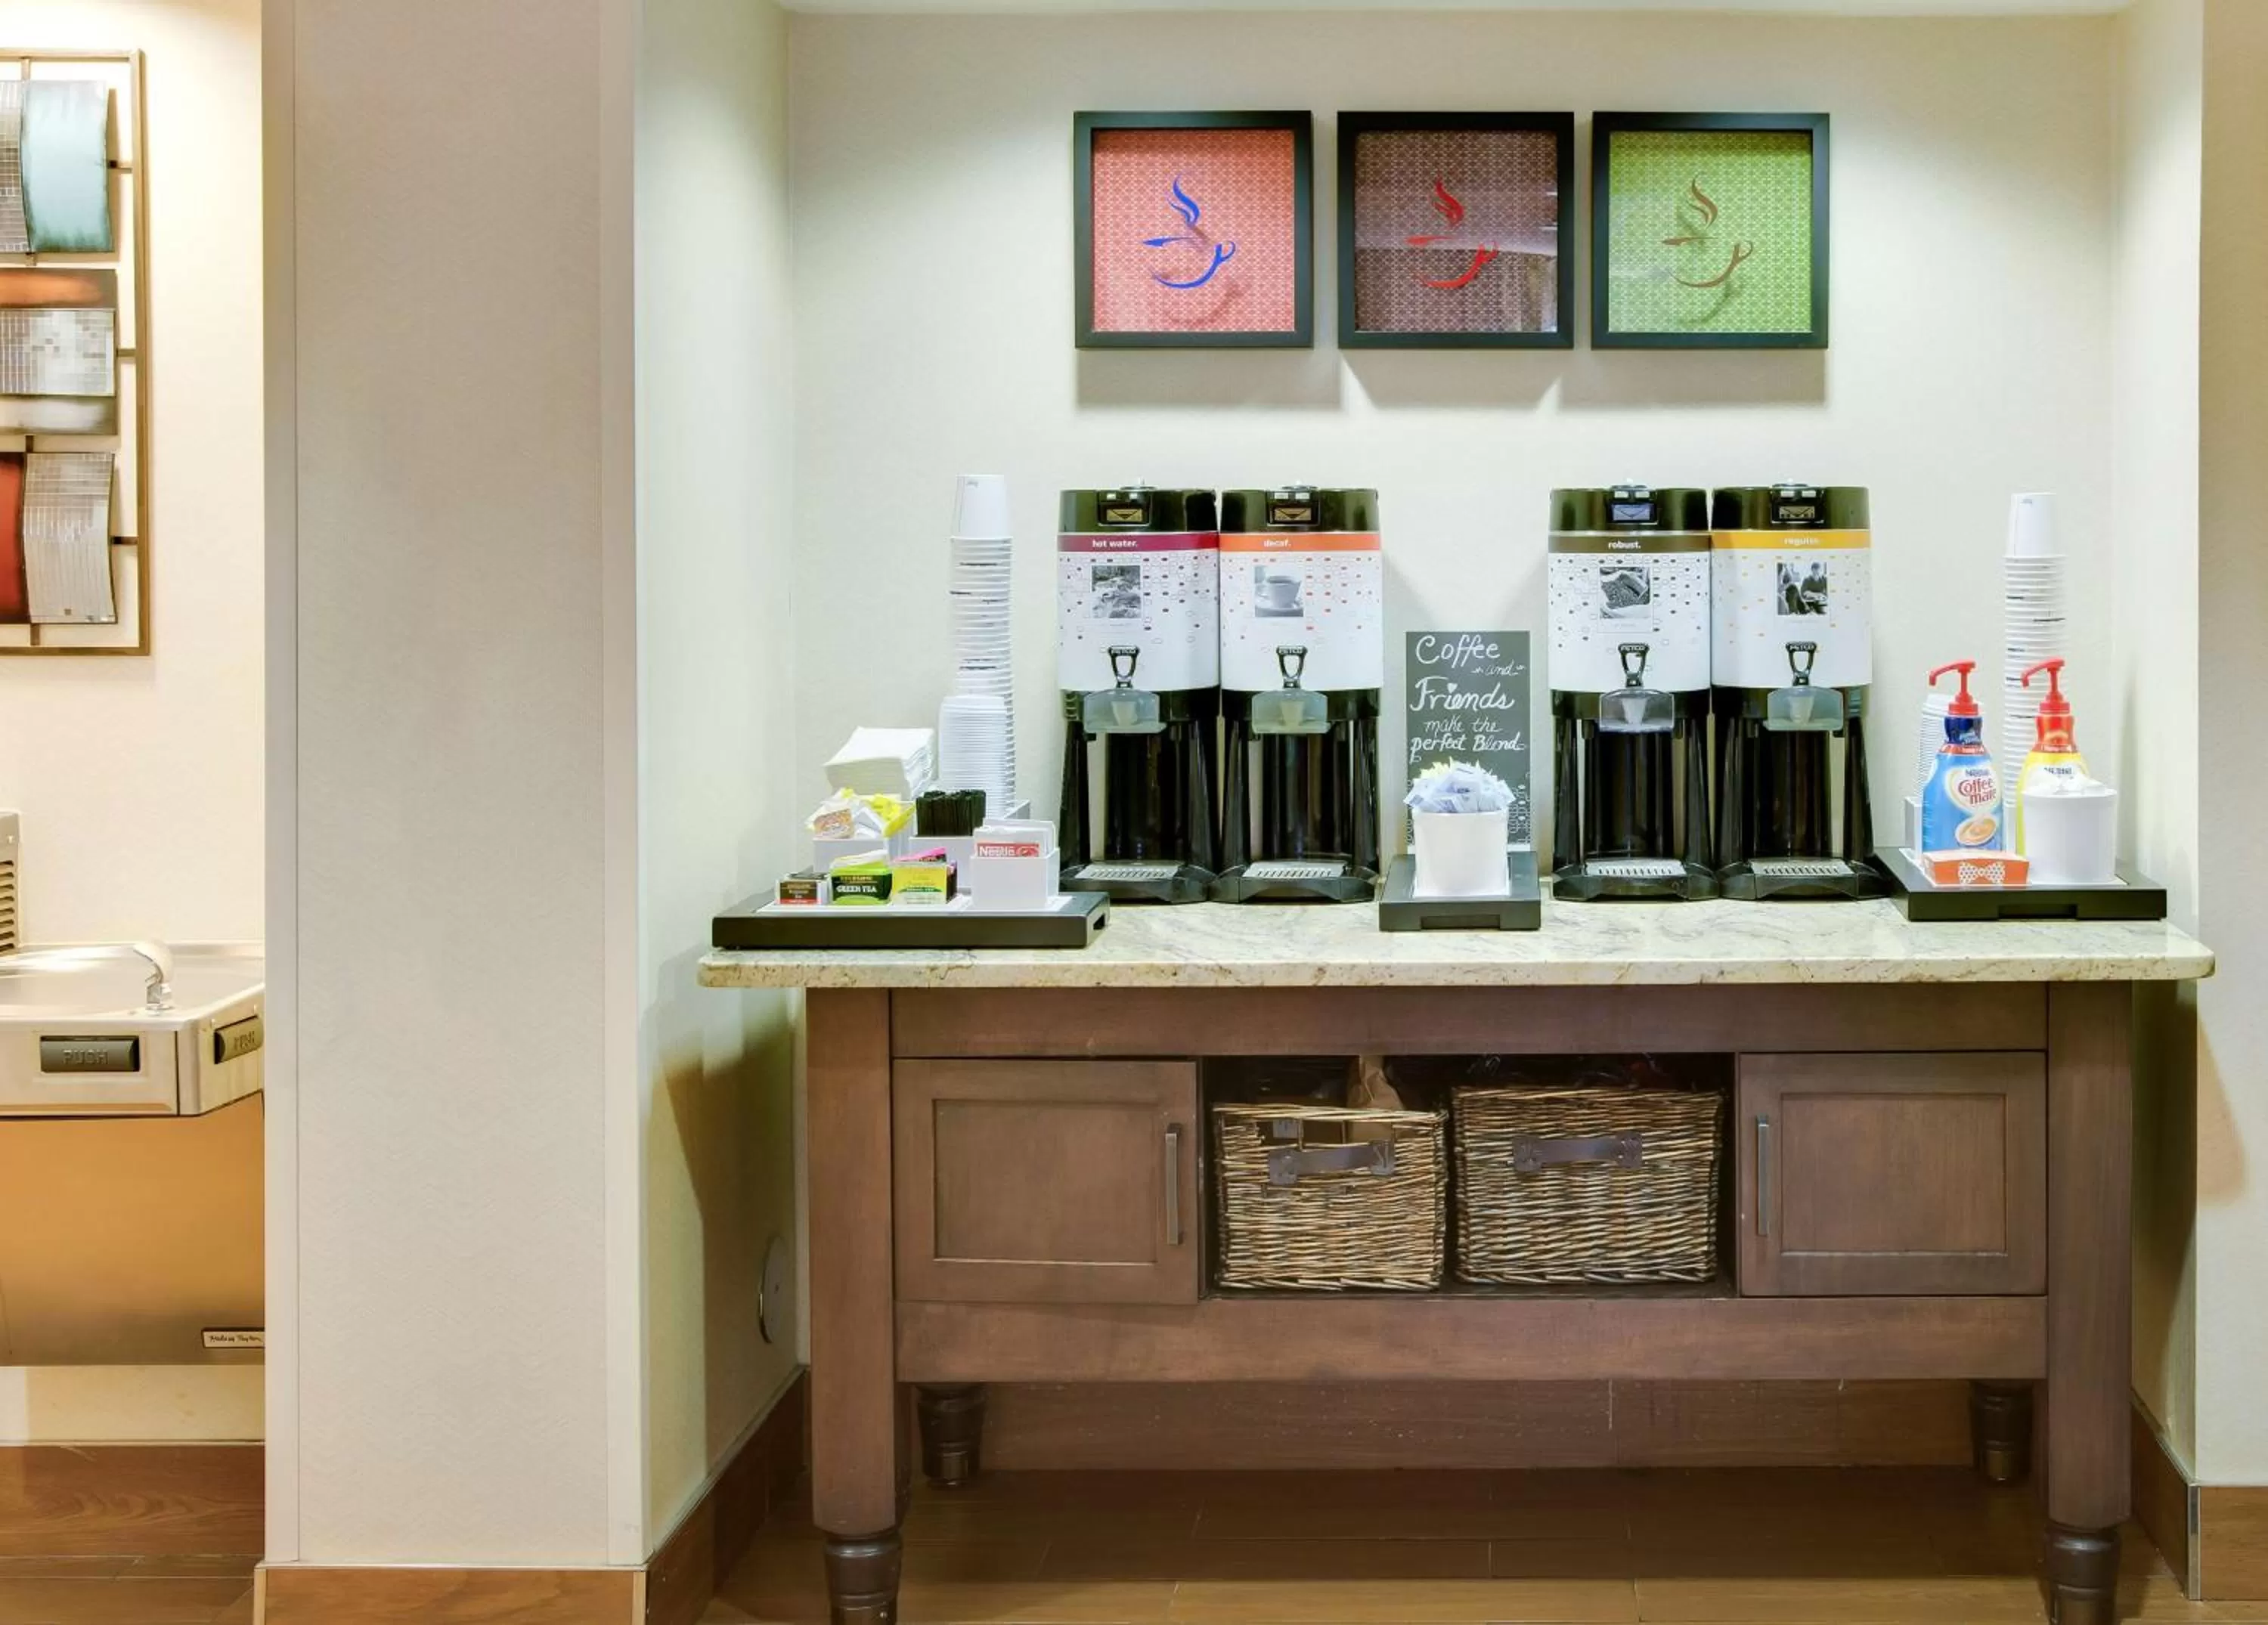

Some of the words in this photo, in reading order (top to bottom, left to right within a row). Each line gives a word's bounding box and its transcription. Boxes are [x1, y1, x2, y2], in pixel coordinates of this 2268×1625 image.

[1092, 539, 1108, 548] hot
[1608, 540, 1642, 549] robust.
[1415, 634, 1501, 669] Coffee
[1410, 676, 1515, 711] Friends
[1424, 713, 1464, 733] make
[1470, 717, 1504, 732] the
[1409, 731, 1467, 764] perfect
[1958, 778, 1994, 797] Coffee
[835, 884, 860, 893] GREEN
[862, 884, 877, 893] TEA
